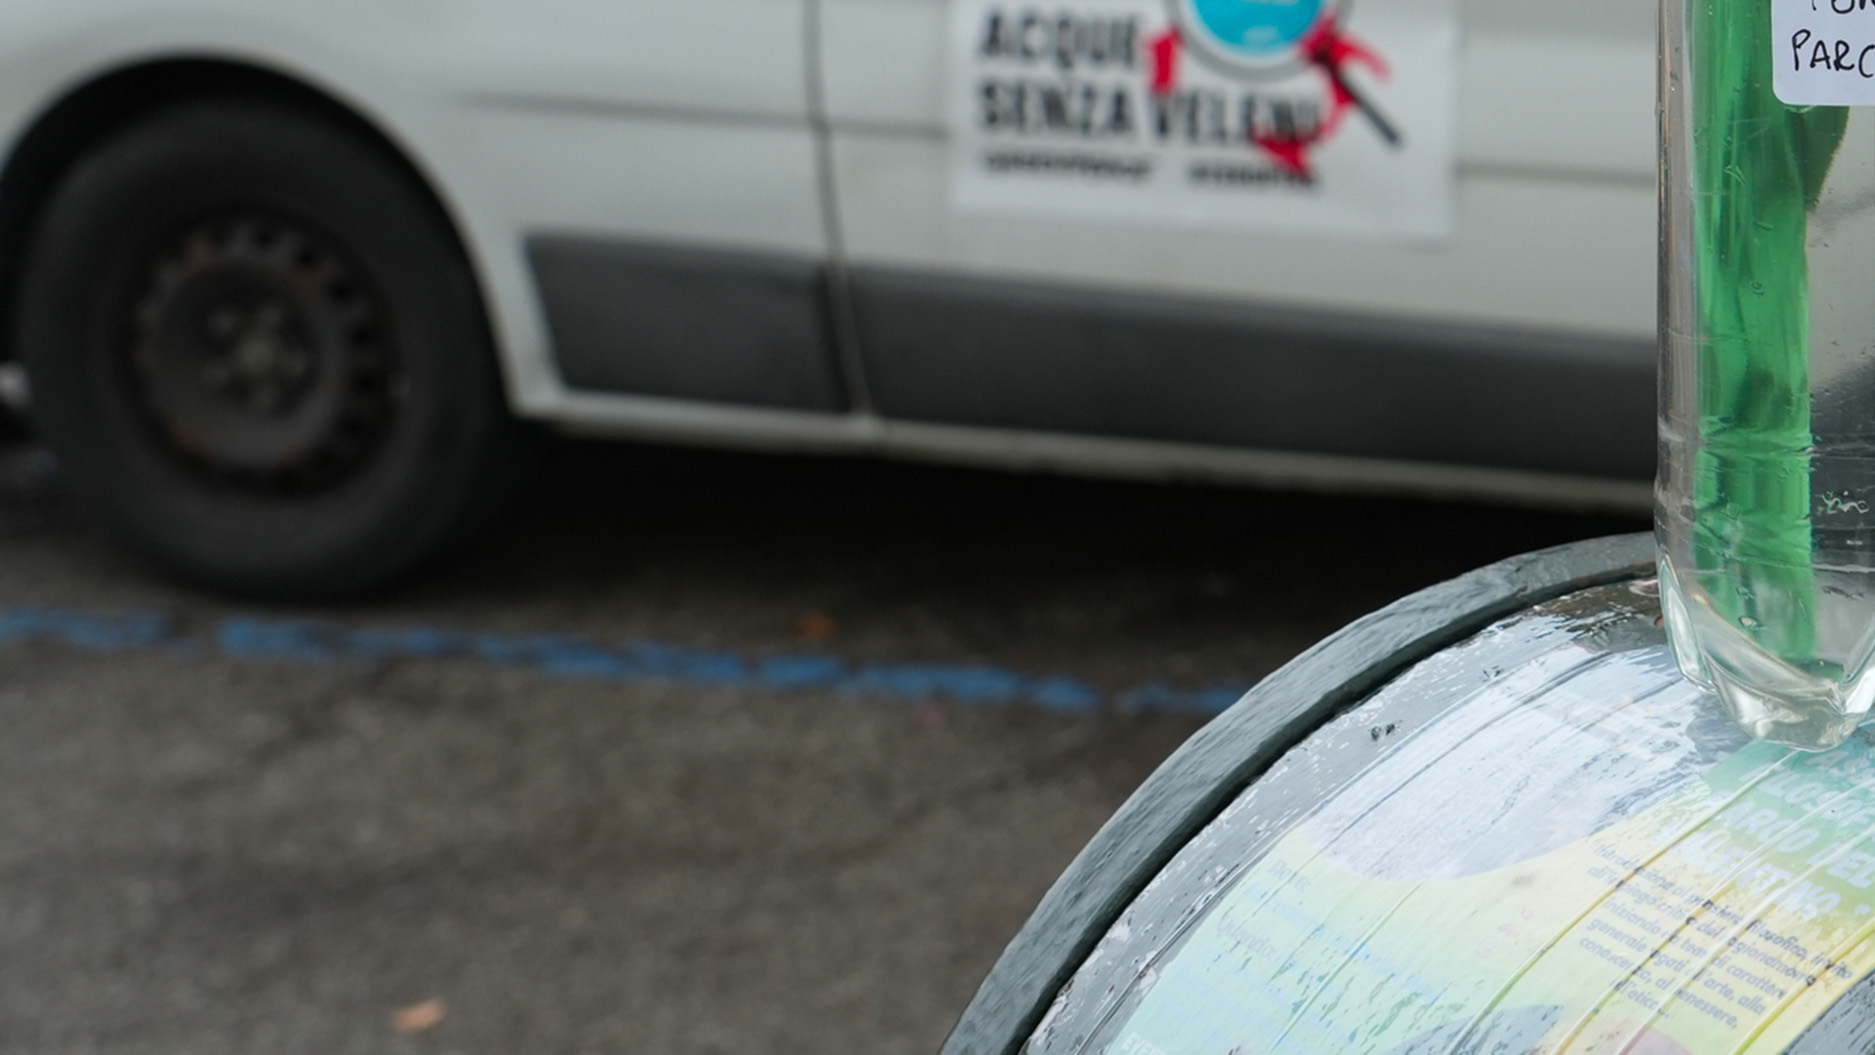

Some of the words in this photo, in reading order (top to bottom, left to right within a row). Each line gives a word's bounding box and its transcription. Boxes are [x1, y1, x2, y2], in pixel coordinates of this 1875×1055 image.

[976, 78, 1135, 134] SENZA
[1587, 917, 1648, 954] generale
[1650, 948, 1690, 974] egati
[1737, 992, 1767, 1015] alla
